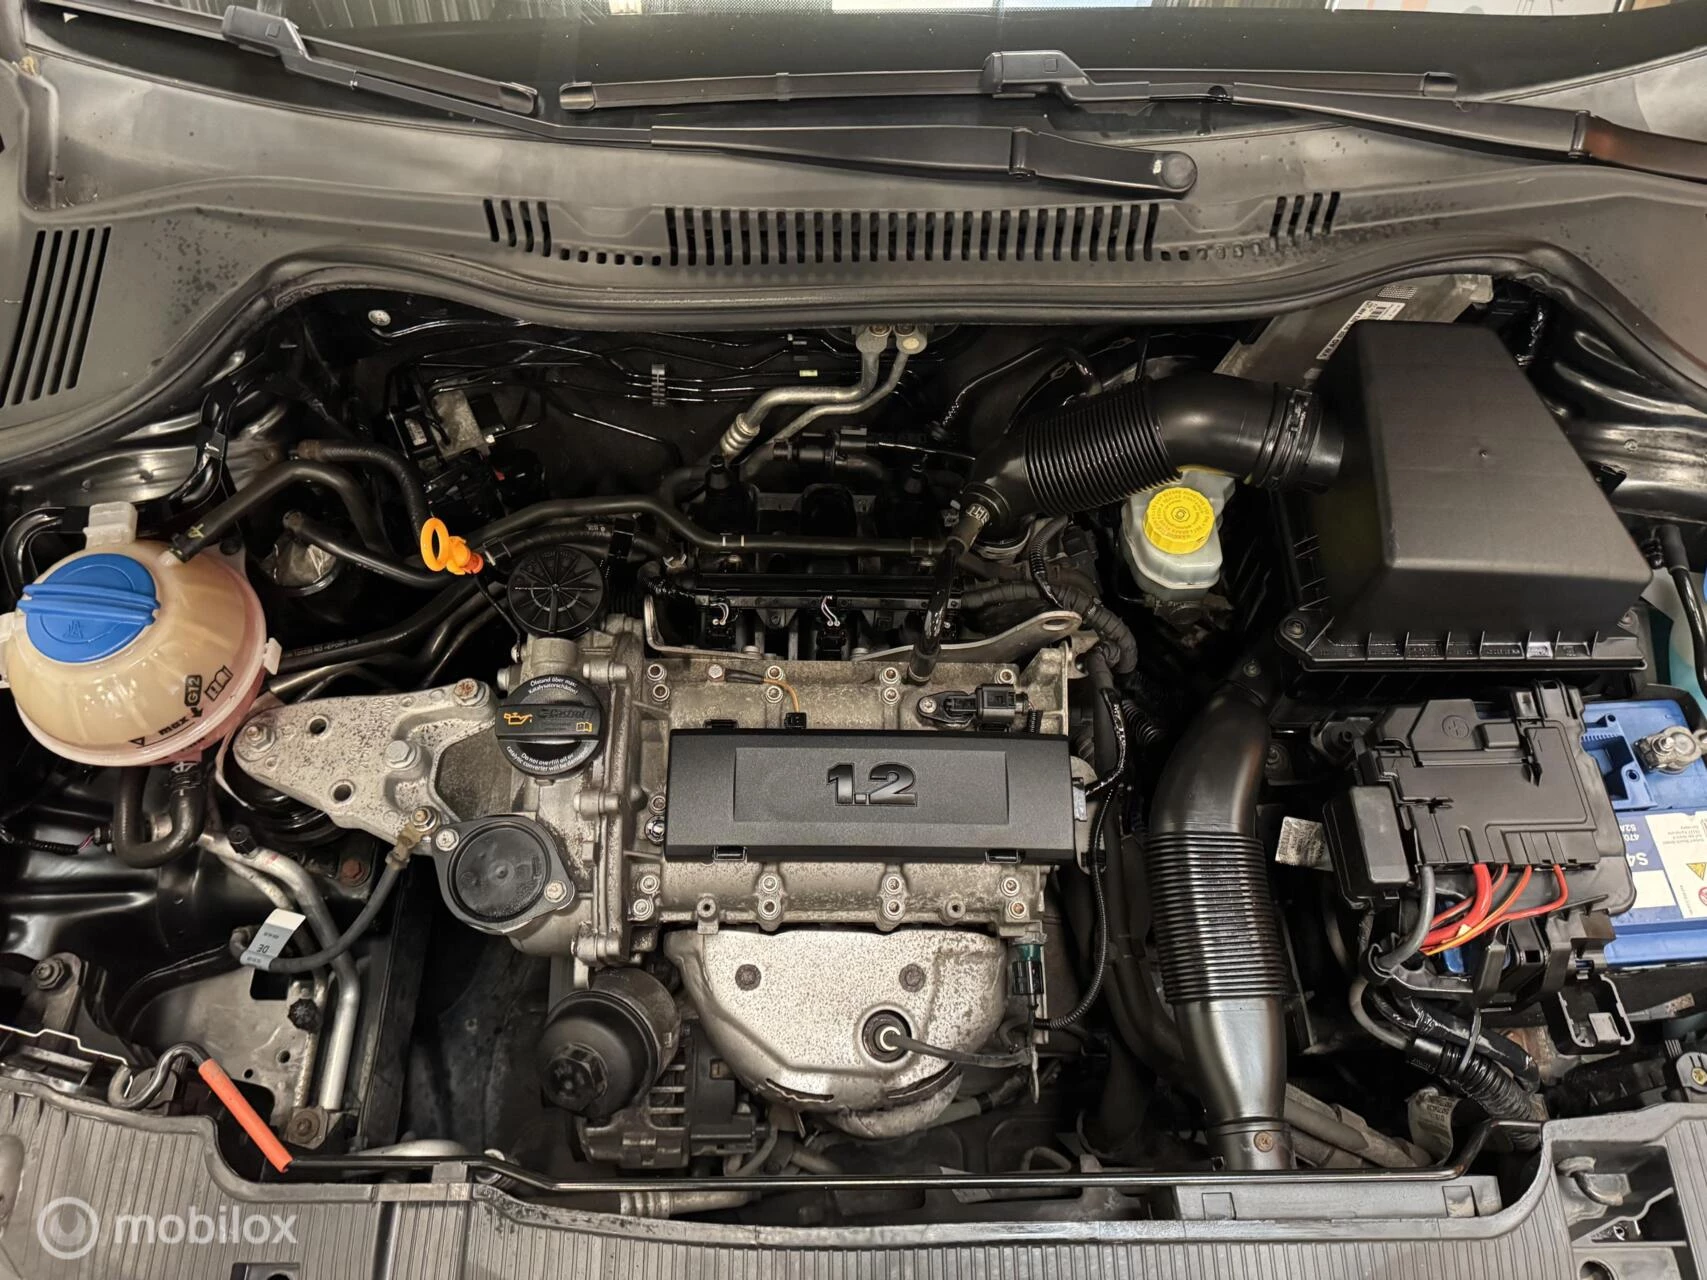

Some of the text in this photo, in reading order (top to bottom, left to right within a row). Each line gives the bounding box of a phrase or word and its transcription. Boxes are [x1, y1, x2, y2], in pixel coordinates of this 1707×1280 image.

[187, 677, 200, 703] G12
[158, 716, 190, 735] max
[827, 763, 917, 806] 1.2
[1626, 852, 1649, 867] S4
